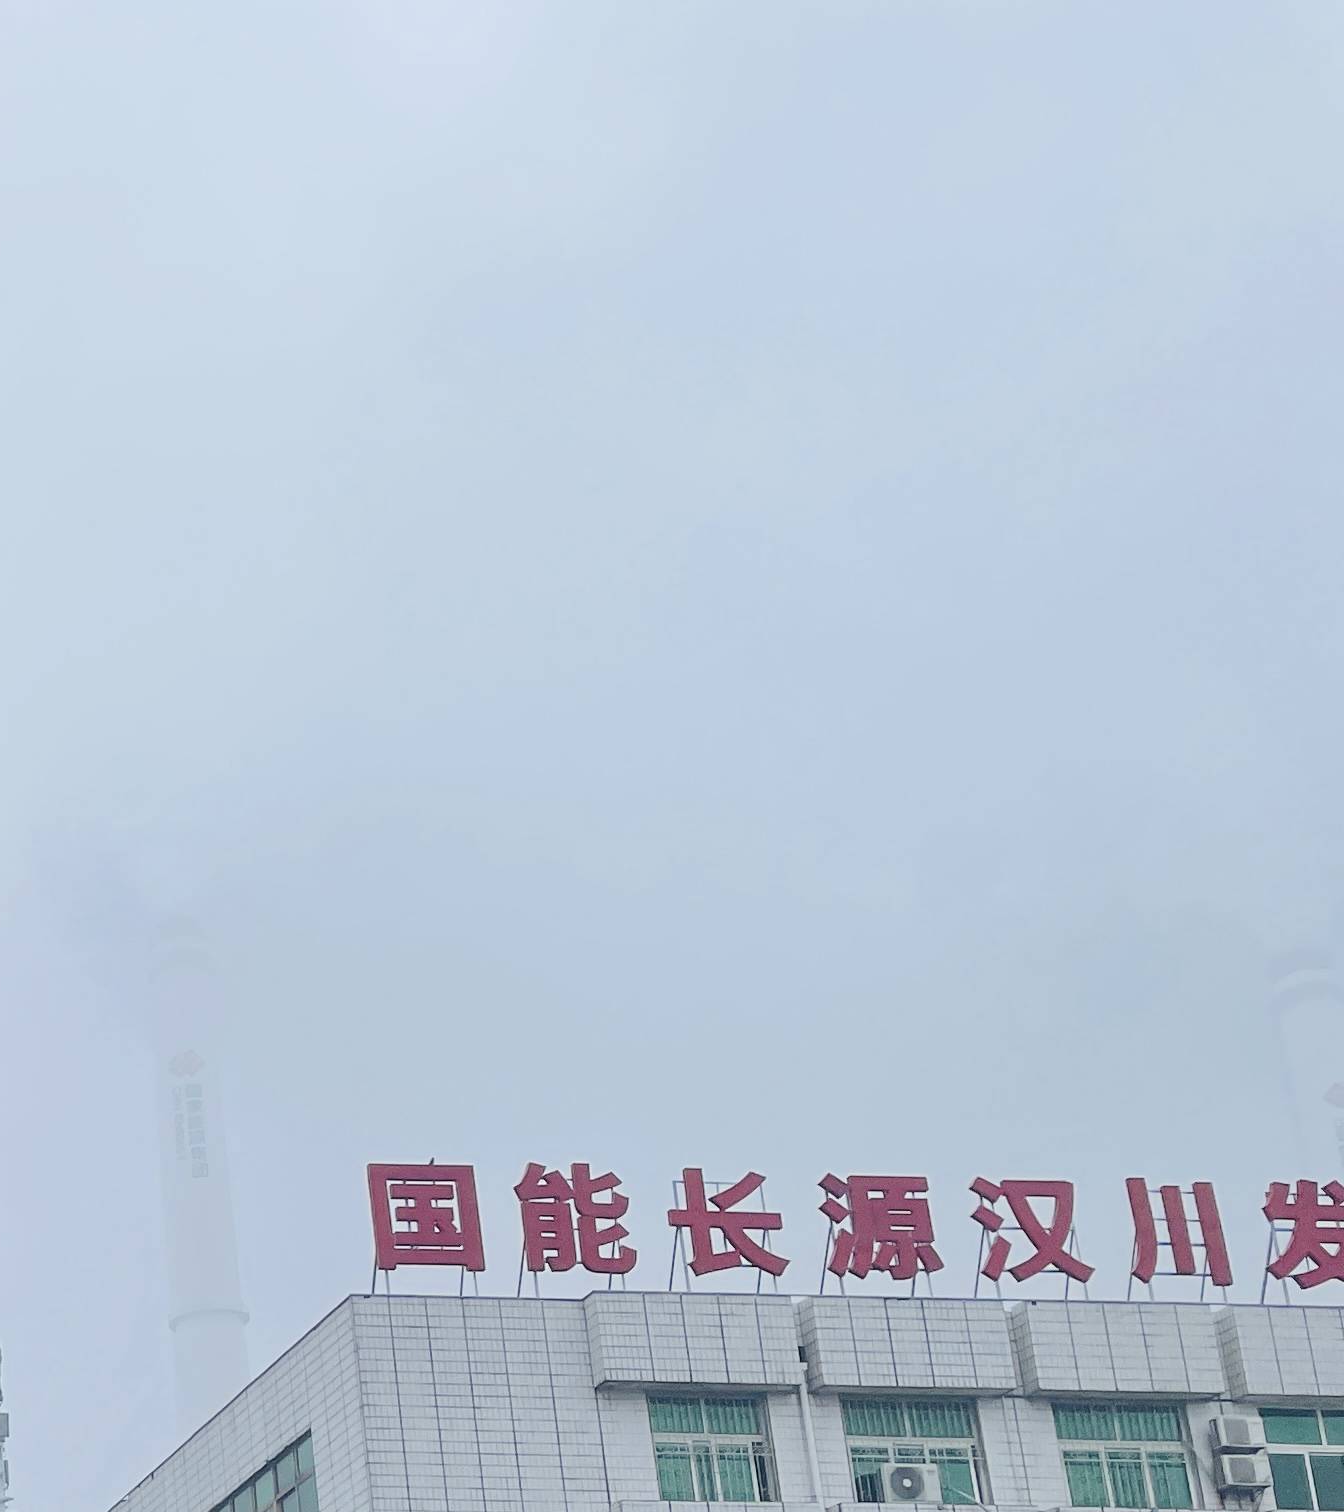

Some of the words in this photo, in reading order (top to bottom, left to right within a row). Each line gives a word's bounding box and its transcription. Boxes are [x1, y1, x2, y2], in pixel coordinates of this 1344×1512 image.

[365, 1160, 1344, 1289] 国能长源汉川发
